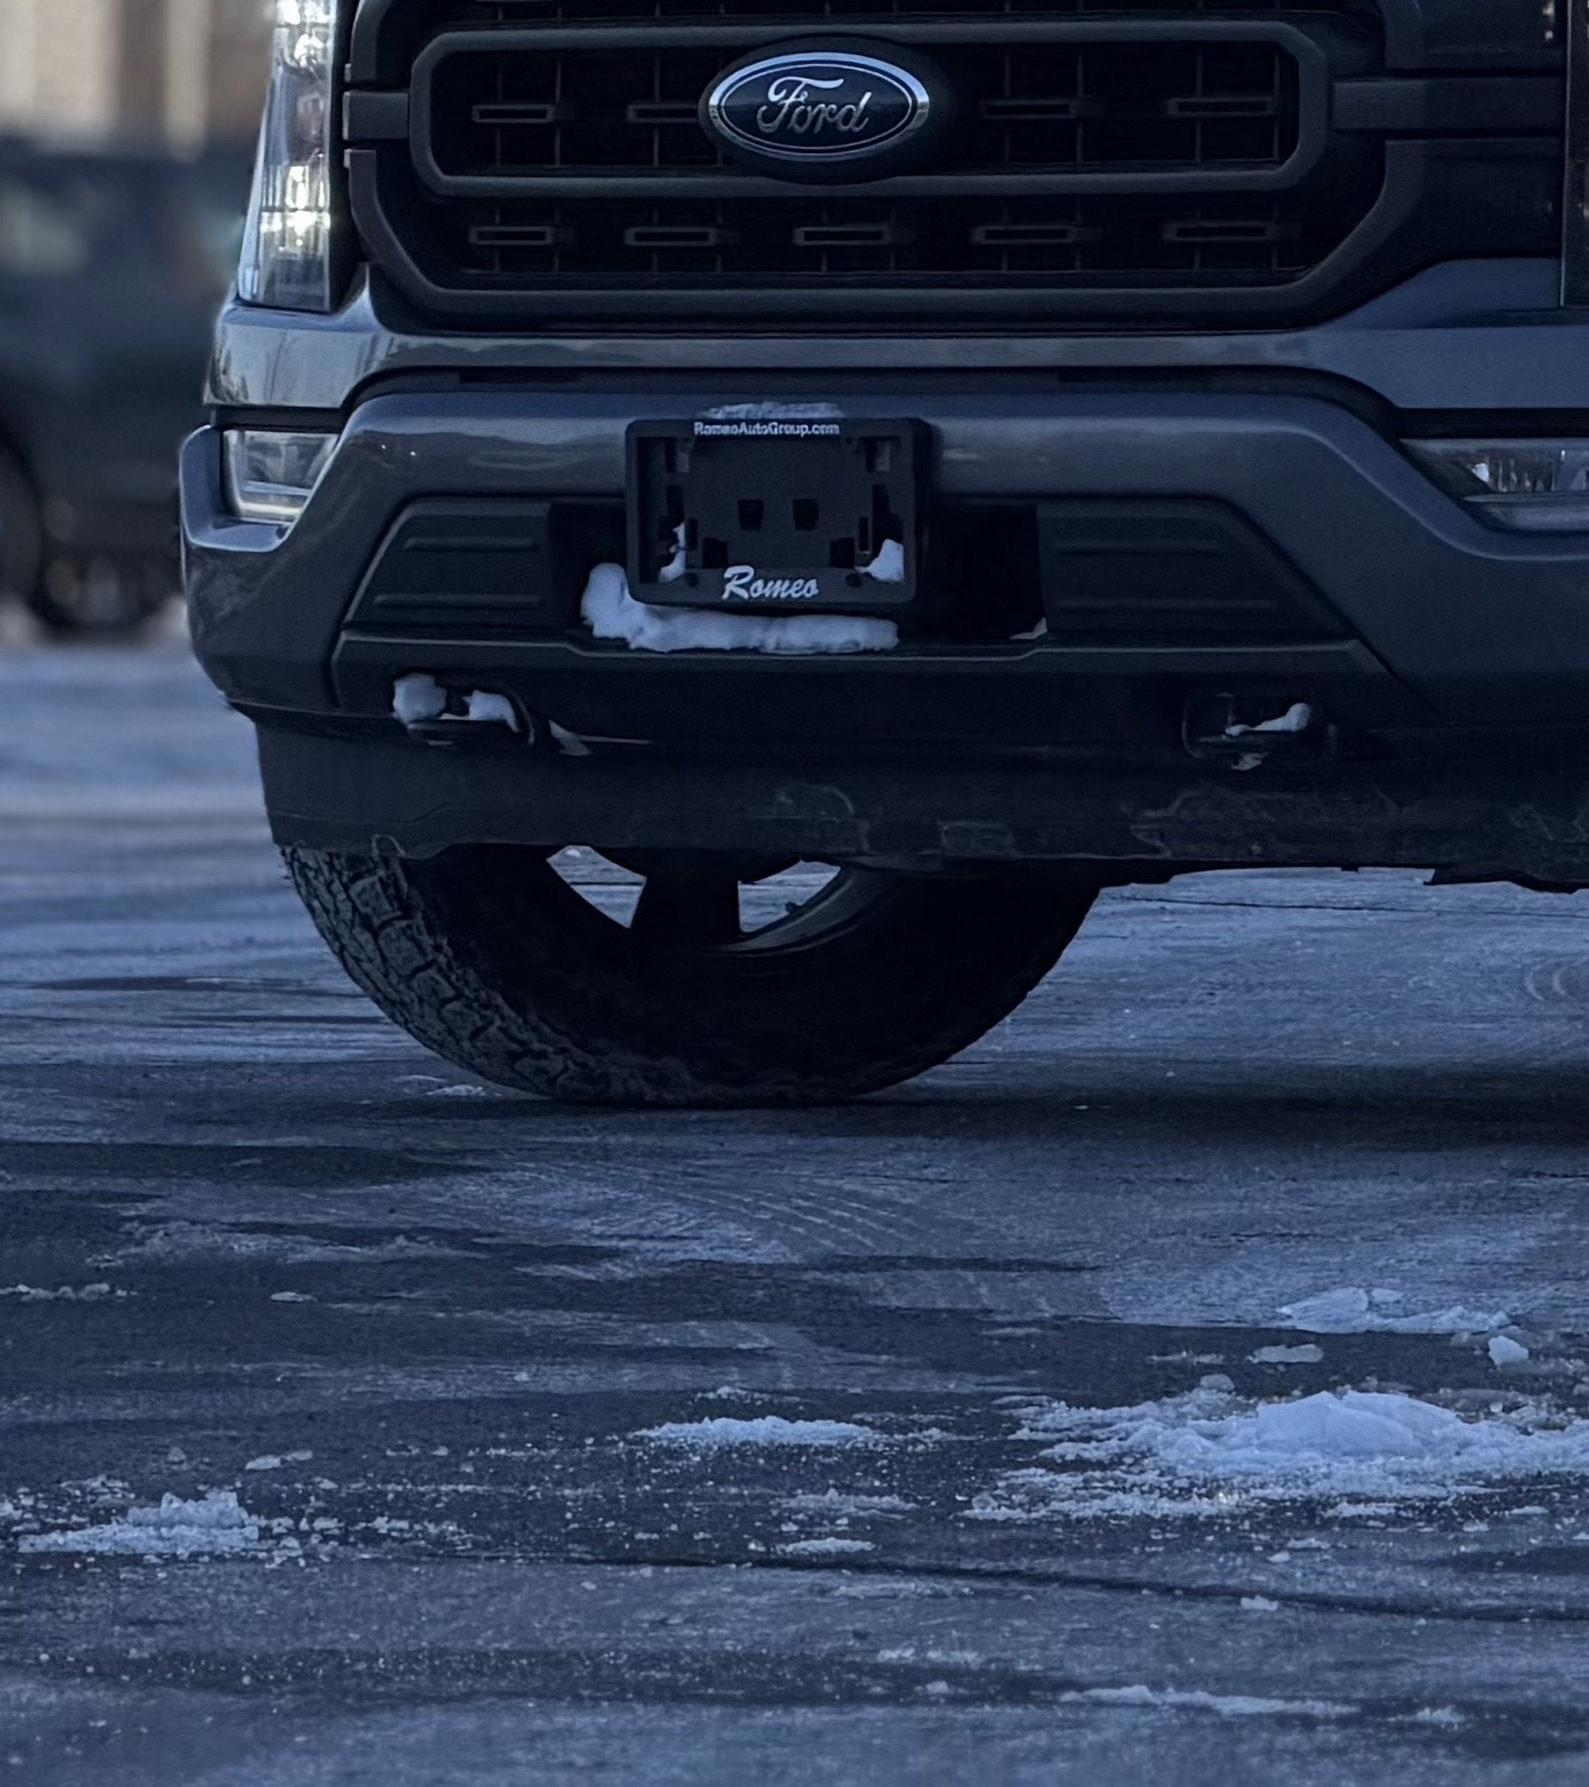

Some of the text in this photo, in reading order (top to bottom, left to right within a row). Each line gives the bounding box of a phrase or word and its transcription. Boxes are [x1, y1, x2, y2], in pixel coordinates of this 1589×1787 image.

[757, 75, 872, 134] Ford
[693, 421, 840, 438] RomeoAutoGroup.com
[721, 564, 820, 600] Romeo
